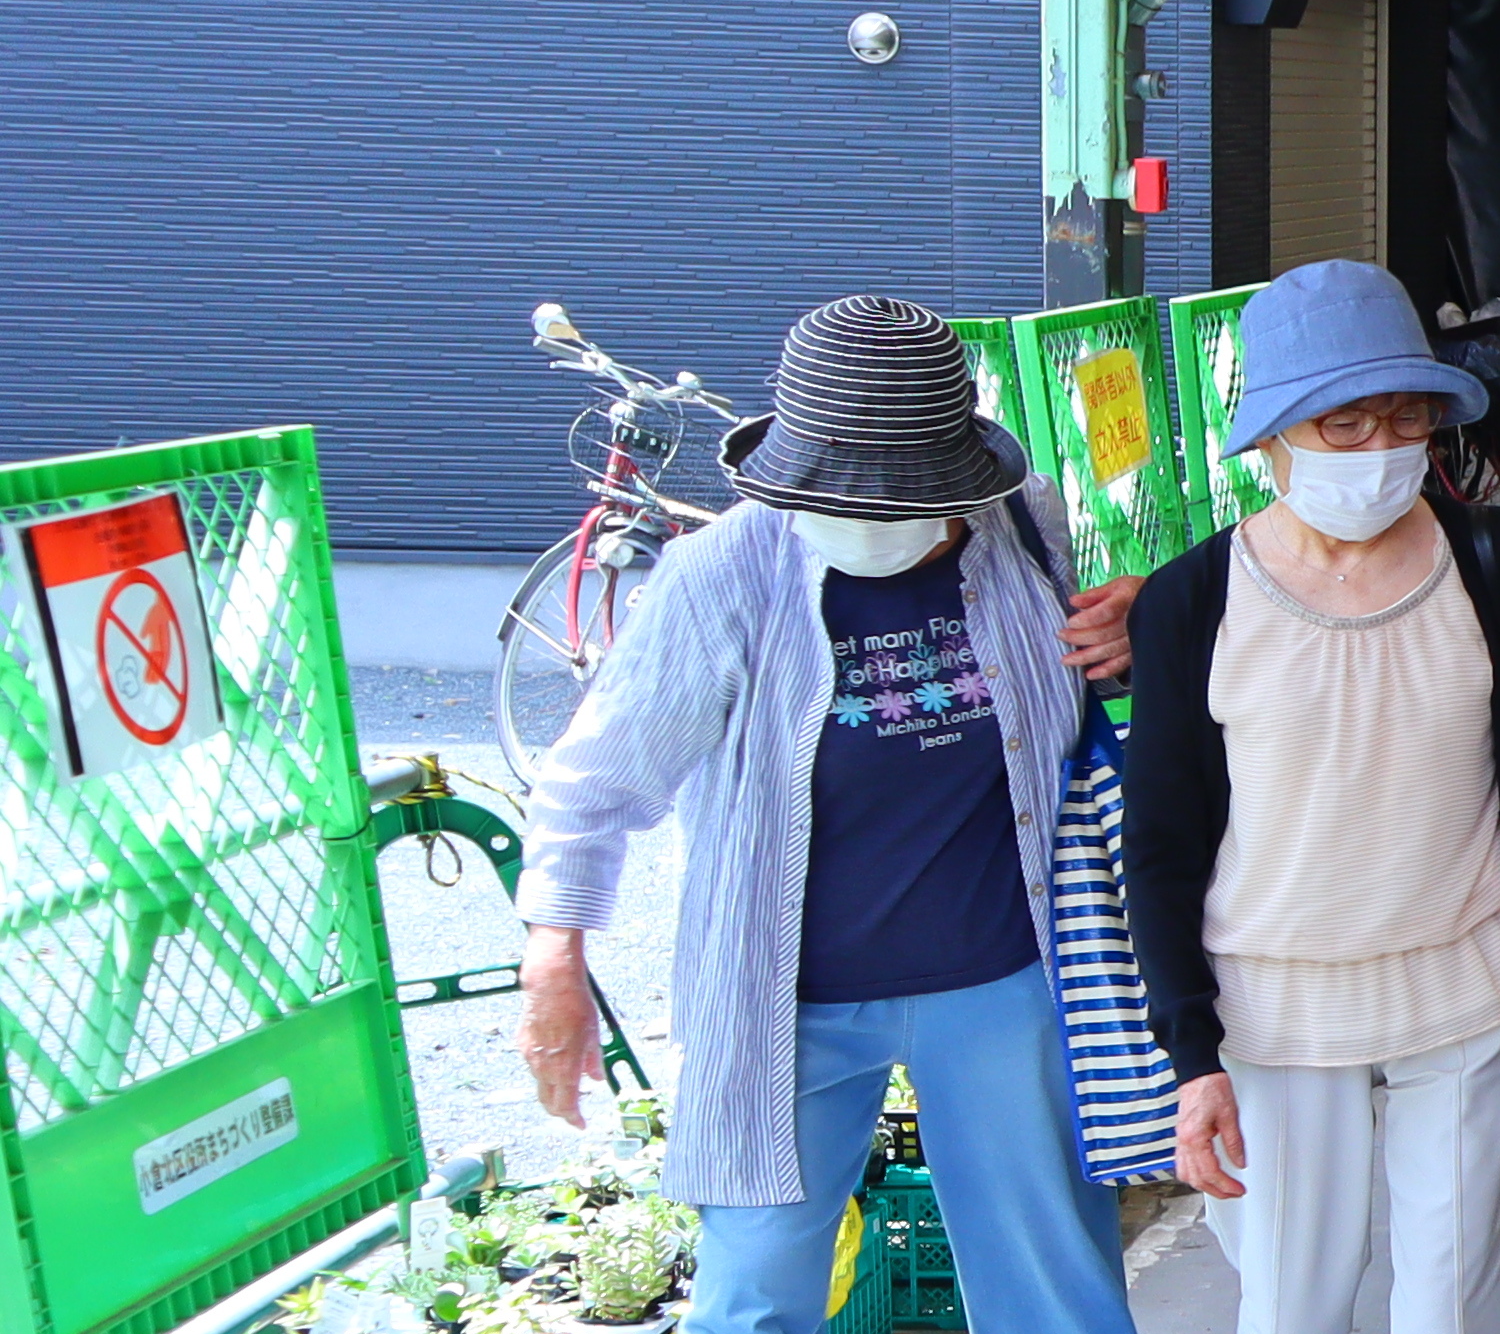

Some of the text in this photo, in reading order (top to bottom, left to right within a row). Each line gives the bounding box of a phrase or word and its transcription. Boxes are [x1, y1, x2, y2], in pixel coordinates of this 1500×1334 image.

[1095, 413, 1142, 461] 立入禁止
[864, 629, 925, 652] many
[876, 717, 938, 738] Michiko
[919, 731, 963, 752] Jeans
[140, 1093, 294, 1197] 小倉北区役所まちづくり整備課
